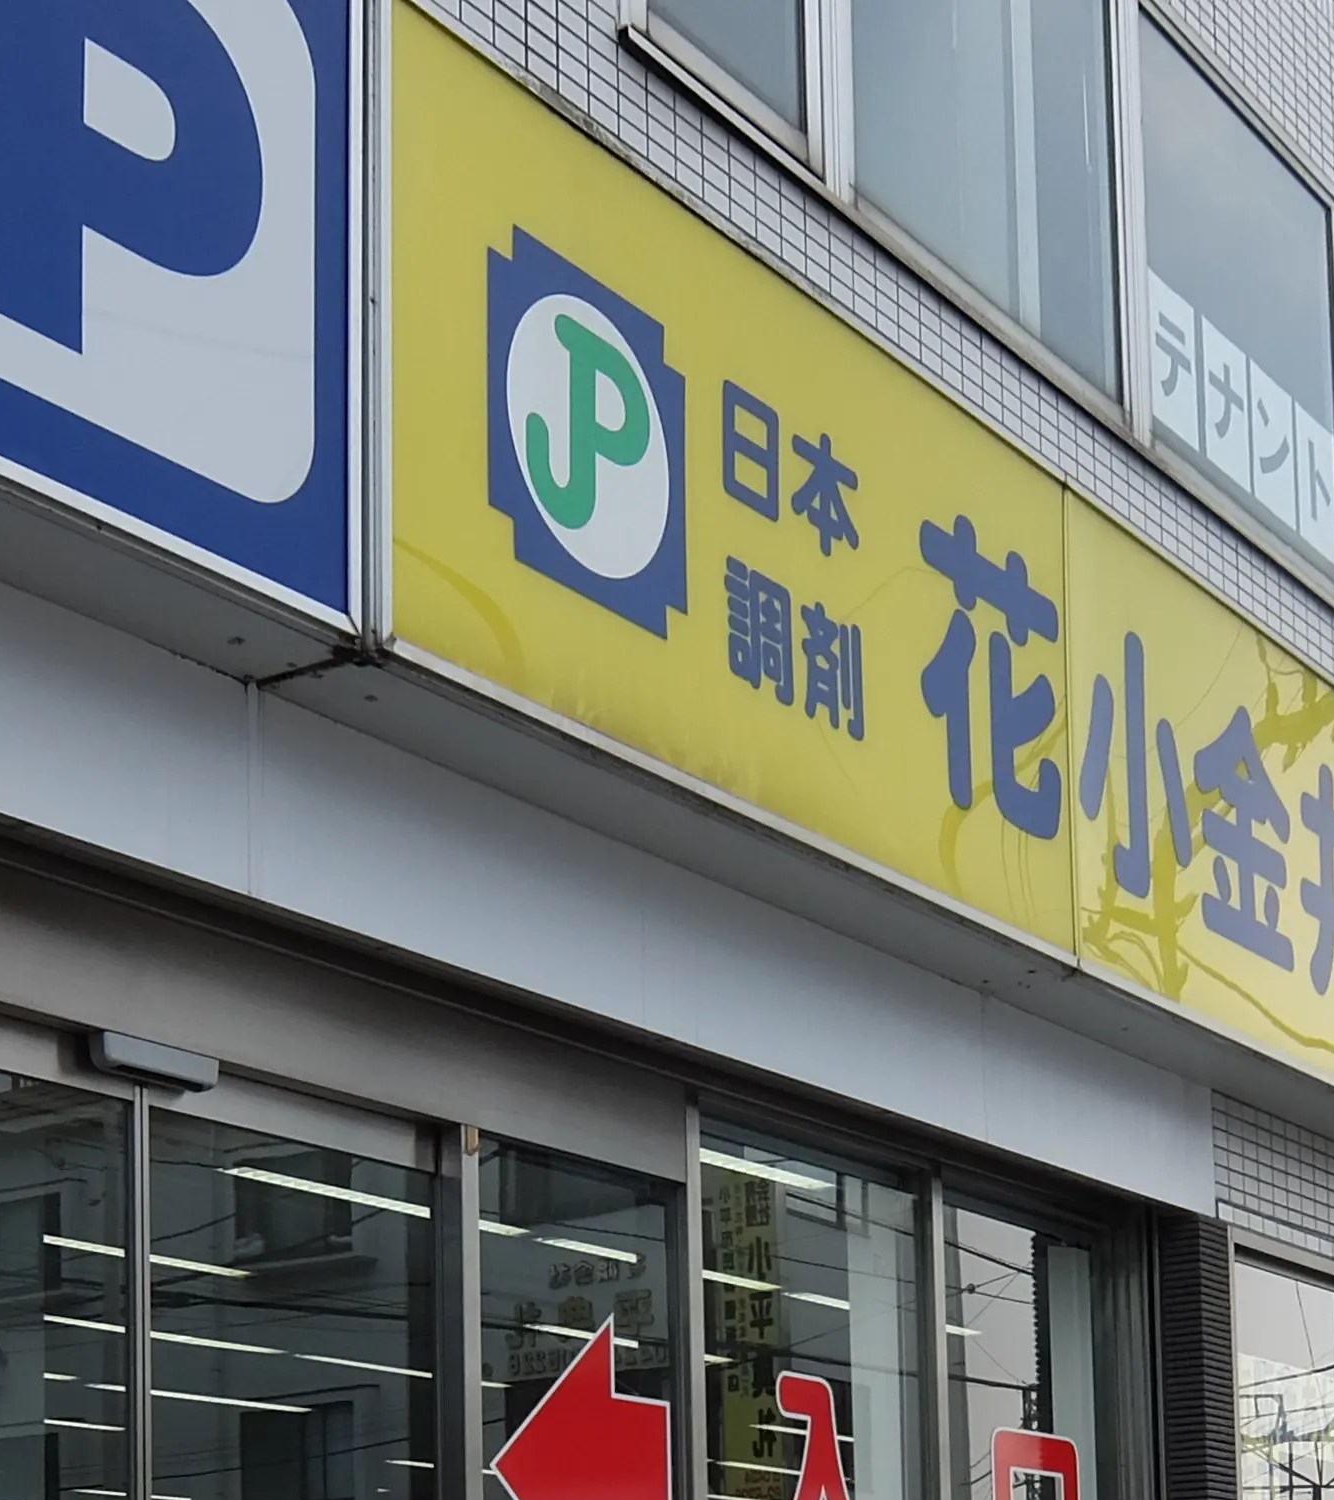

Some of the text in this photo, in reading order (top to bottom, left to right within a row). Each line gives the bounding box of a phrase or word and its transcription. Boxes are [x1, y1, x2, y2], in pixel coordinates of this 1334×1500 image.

[722, 381, 860, 556] 日本
[1154, 316, 1331, 522] テナント
[725, 555, 865, 741] 調剤
